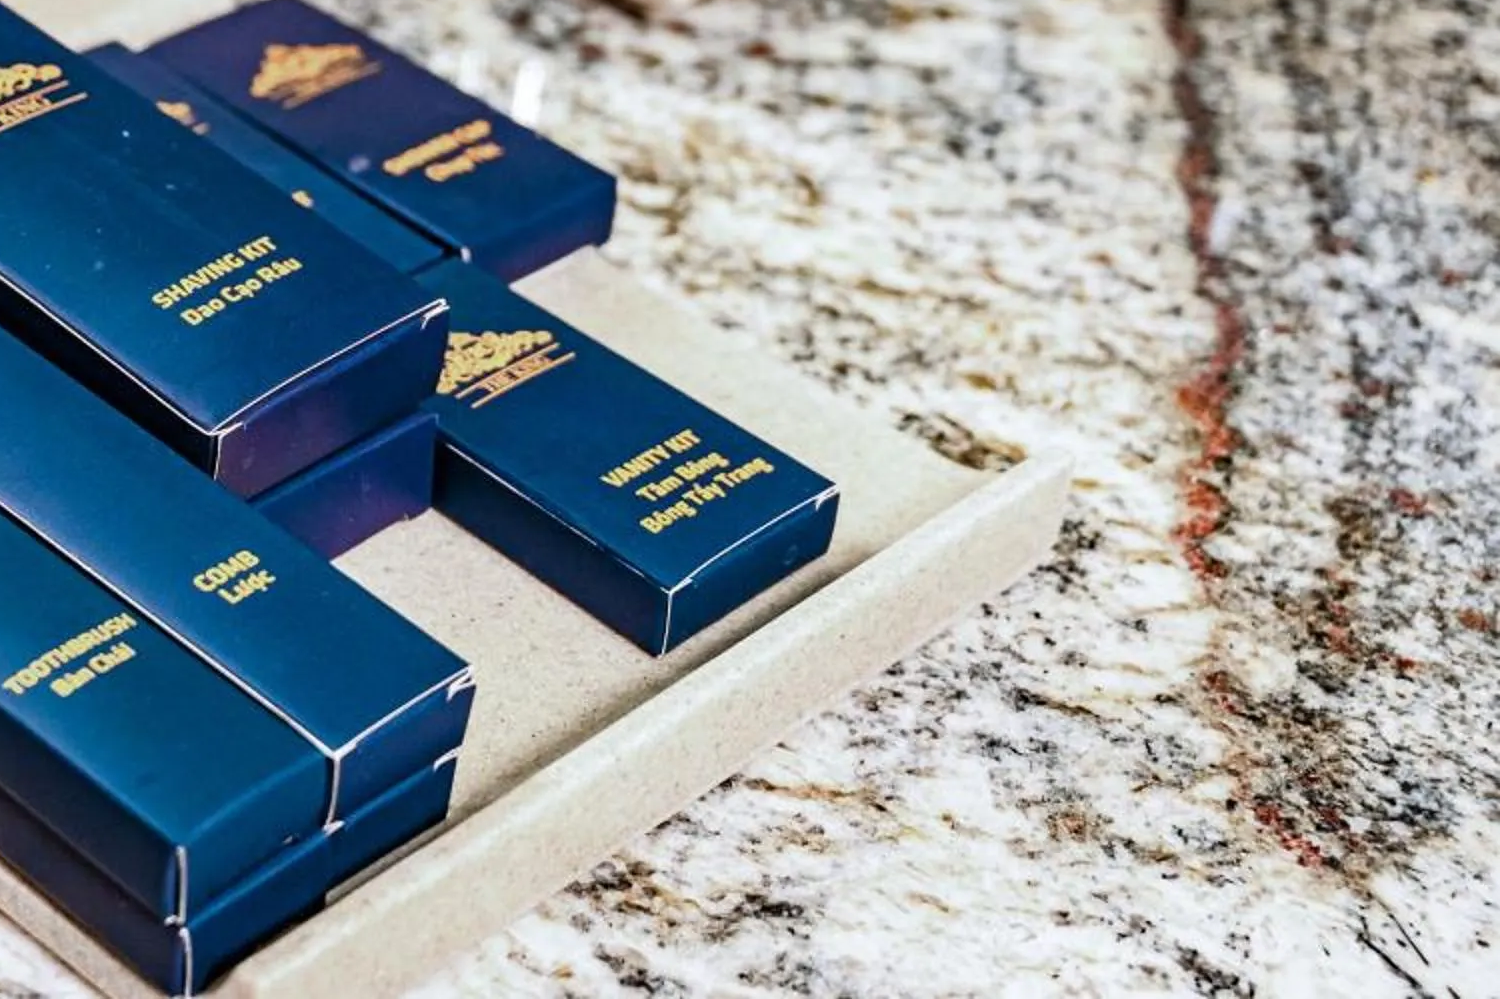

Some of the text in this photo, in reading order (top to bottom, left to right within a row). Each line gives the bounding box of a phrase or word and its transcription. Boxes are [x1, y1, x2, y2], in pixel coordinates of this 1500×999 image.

[152, 235, 277, 309] SHAVING KIT
[179, 257, 303, 326] Dao Cạo Râu
[599, 428, 701, 488] VANITY KIT
[712, 457, 775, 488] Trang
[193, 550, 260, 592] COMB
[1, 612, 137, 695] TOOTHBRUSH
